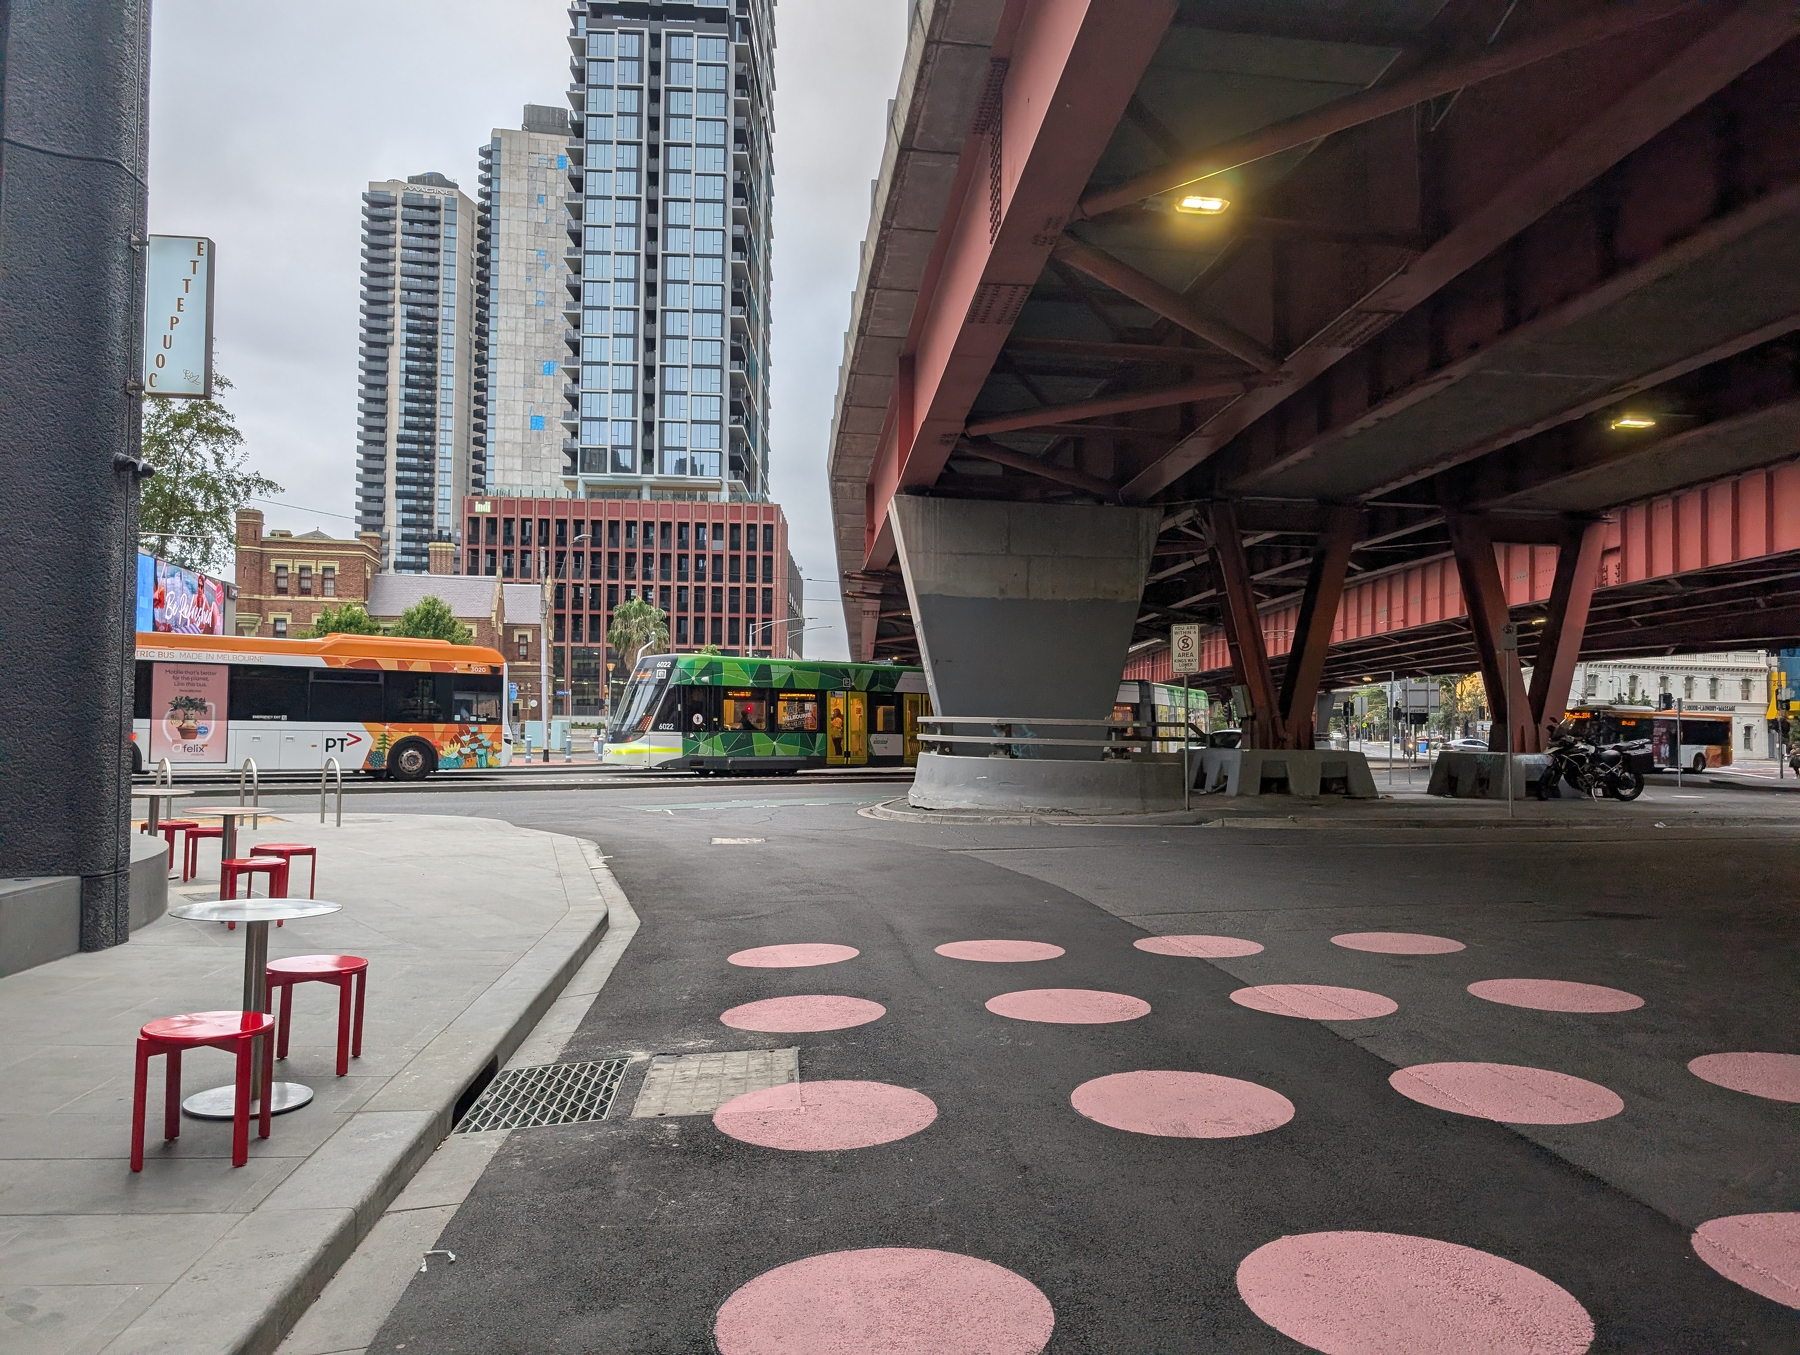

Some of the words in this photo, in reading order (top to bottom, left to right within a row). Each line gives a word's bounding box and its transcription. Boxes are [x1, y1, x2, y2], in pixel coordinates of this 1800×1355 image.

[402, 185, 454, 196] IMAGINE
[475, 501, 491, 513] indi
[165, 590, 180, 620] Be
[179, 593, 214, 627] Refreshed
[157, 651, 175, 659] BUS
[179, 652, 203, 660] MADE
[216, 653, 264, 663] MELBOURNE
[183, 743, 205, 753] felix
